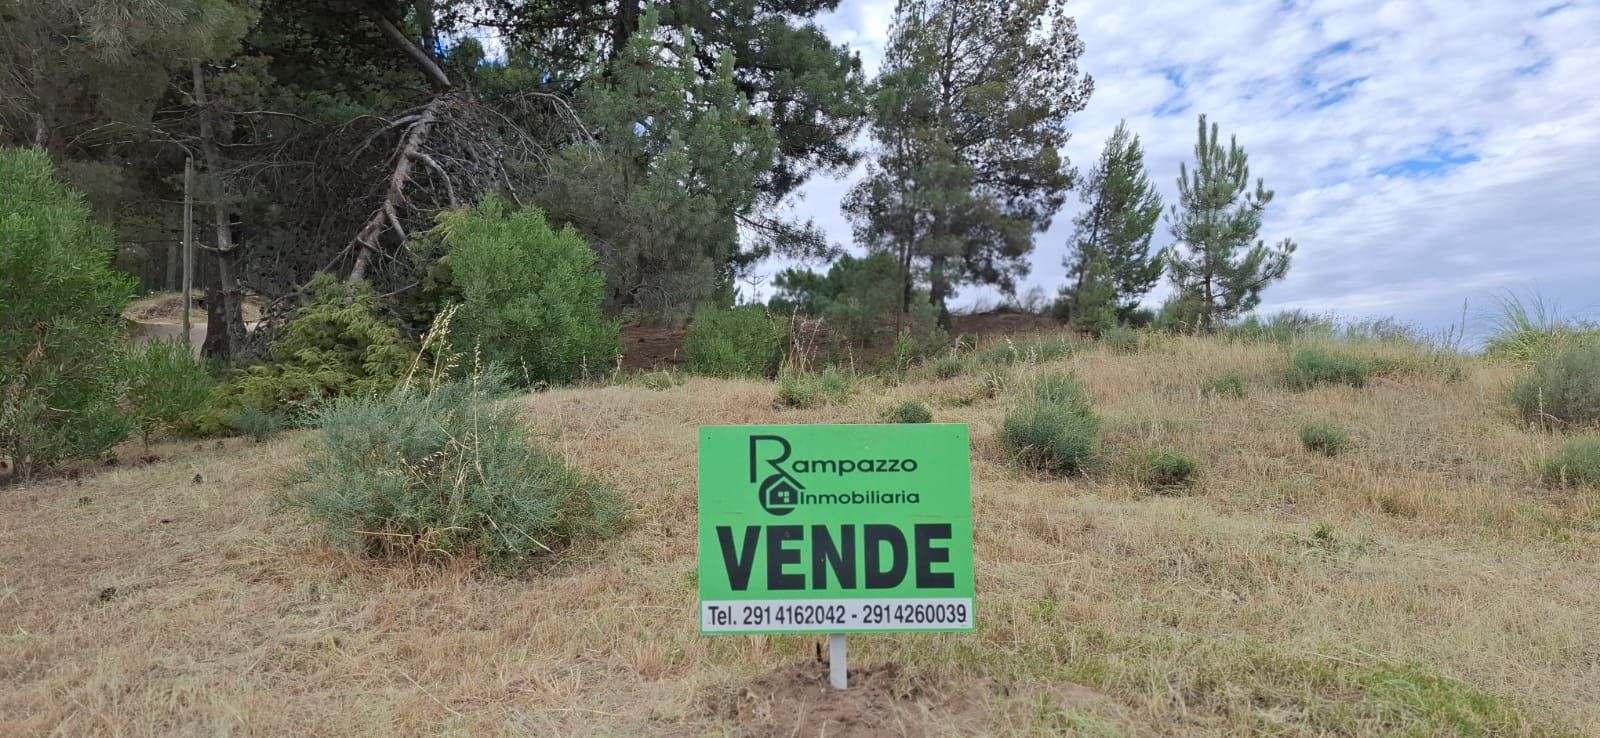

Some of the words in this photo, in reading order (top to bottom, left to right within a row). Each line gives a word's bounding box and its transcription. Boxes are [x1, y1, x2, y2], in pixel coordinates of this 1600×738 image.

[749, 434, 918, 489] Rampazzo
[800, 490, 920, 505] Inmobiliaria
[715, 523, 955, 591] VENDE
[708, 605, 737, 625] Tel.
